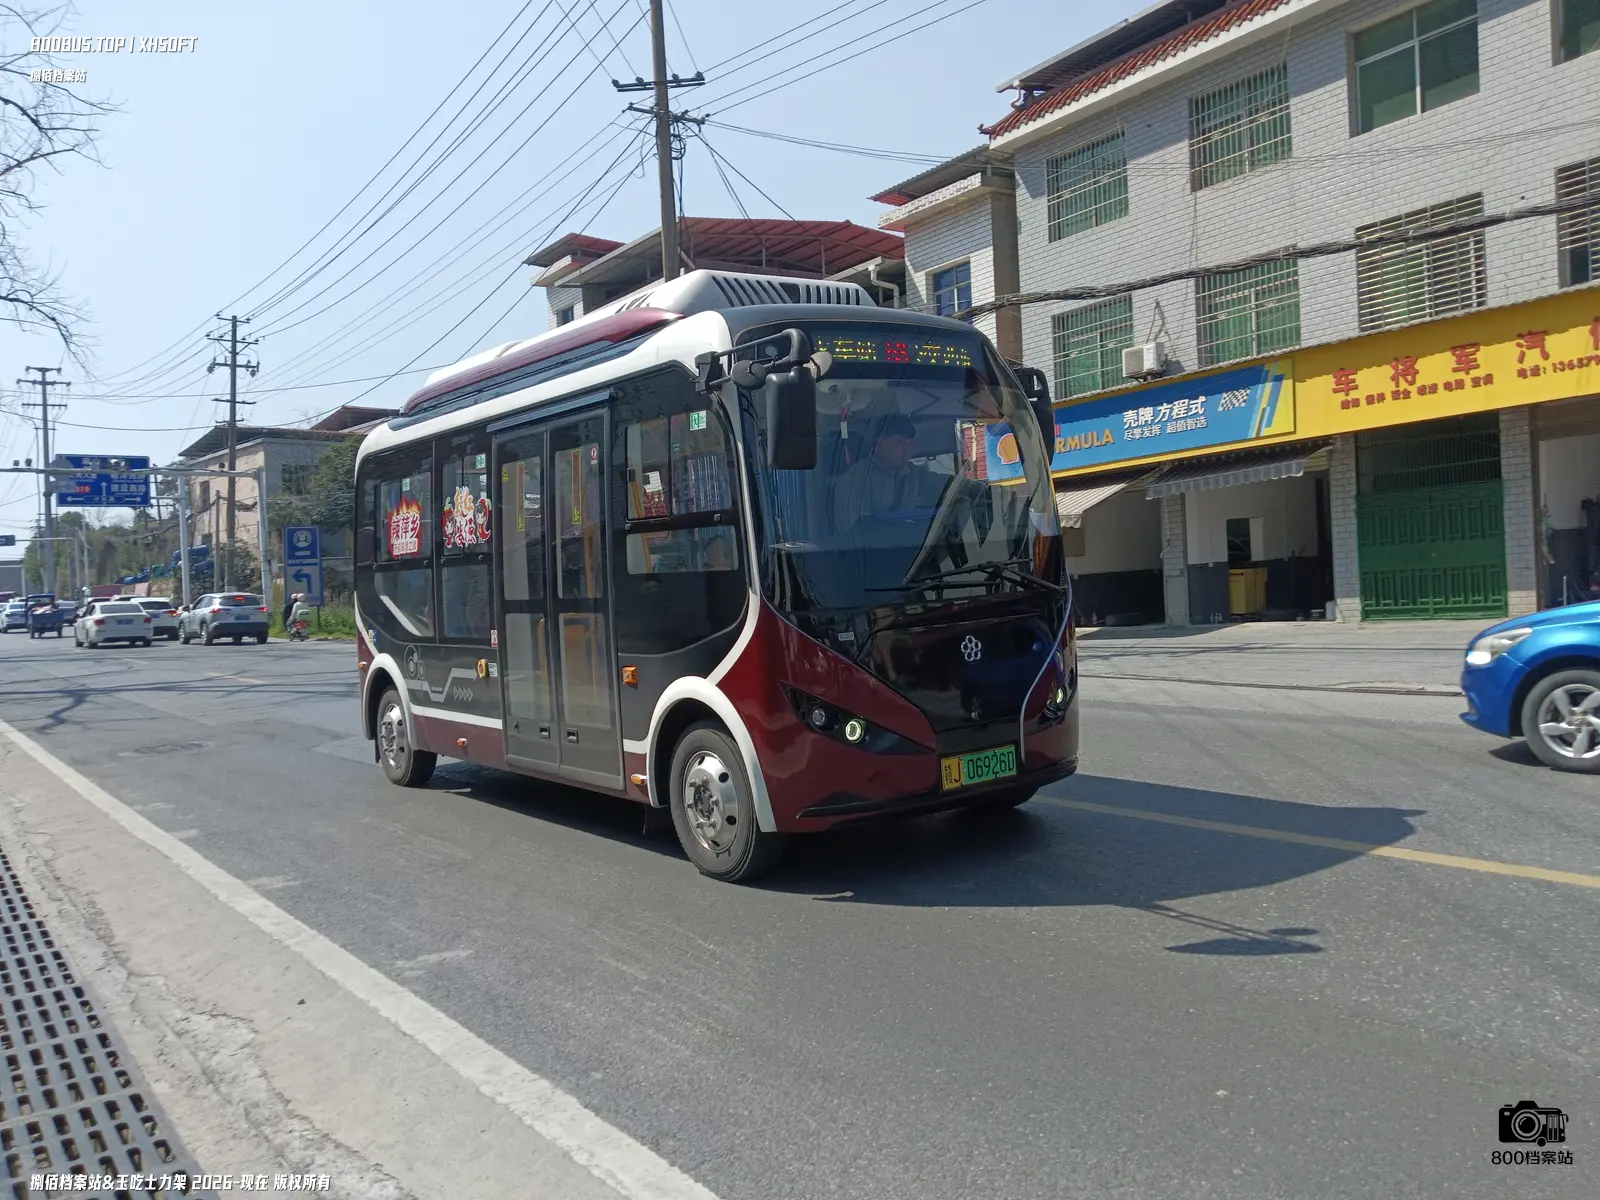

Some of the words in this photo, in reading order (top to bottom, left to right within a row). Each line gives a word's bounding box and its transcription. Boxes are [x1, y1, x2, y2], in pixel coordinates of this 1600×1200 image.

[1167, 416, 1208, 434] 超值智选
[1055, 428, 1116, 454] RMULA
